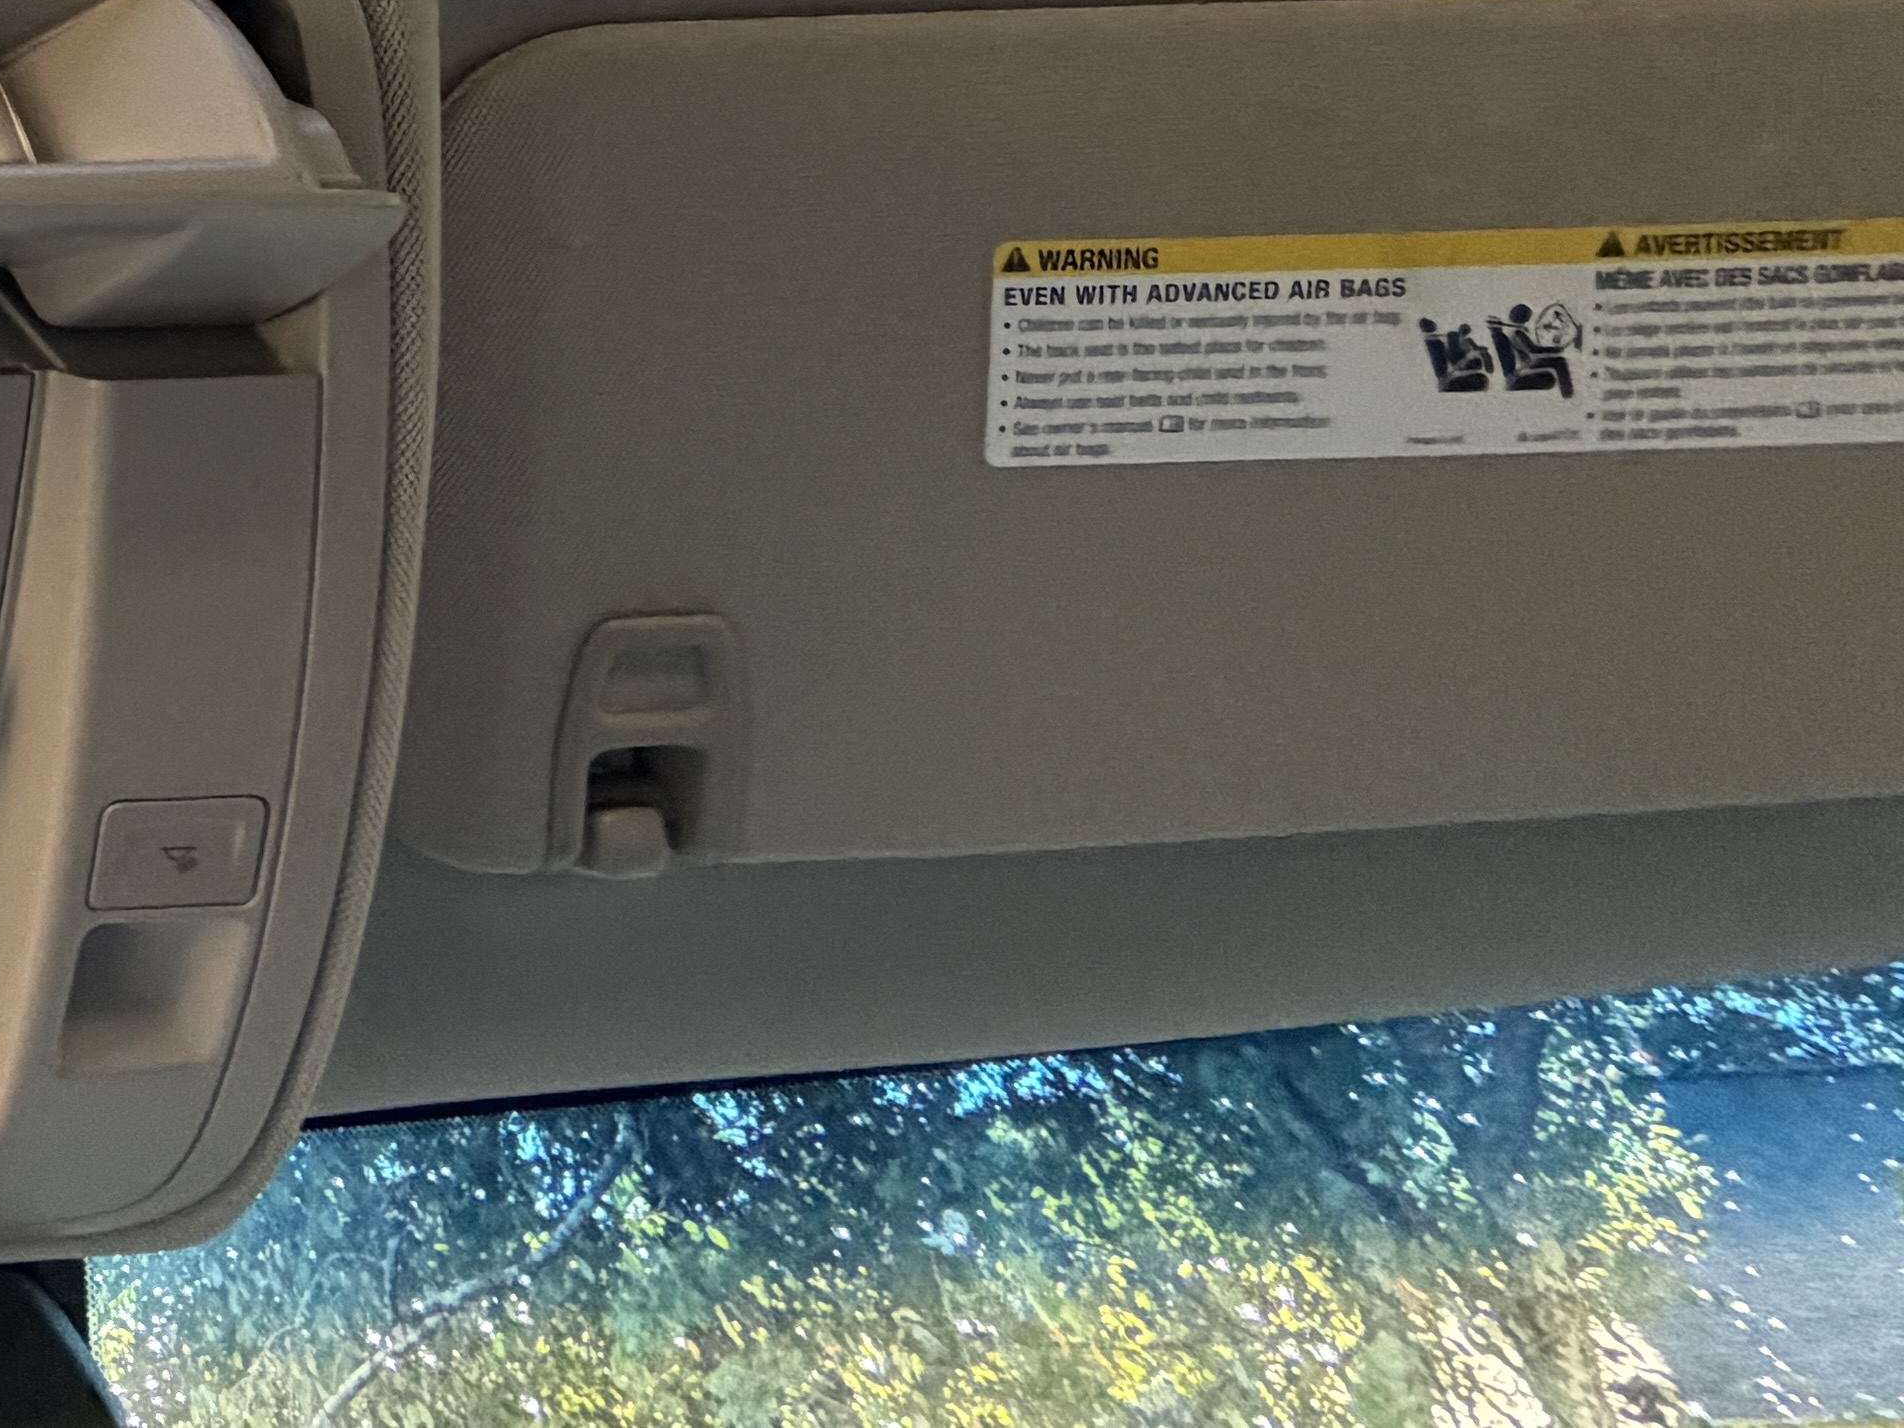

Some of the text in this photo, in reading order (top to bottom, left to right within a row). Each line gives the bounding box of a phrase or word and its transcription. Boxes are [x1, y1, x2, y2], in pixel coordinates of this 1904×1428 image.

[1038, 248, 1158, 273] WARNING
[1003, 277, 1406, 307] EVEN WITH ADVANCED AIR BAGS
